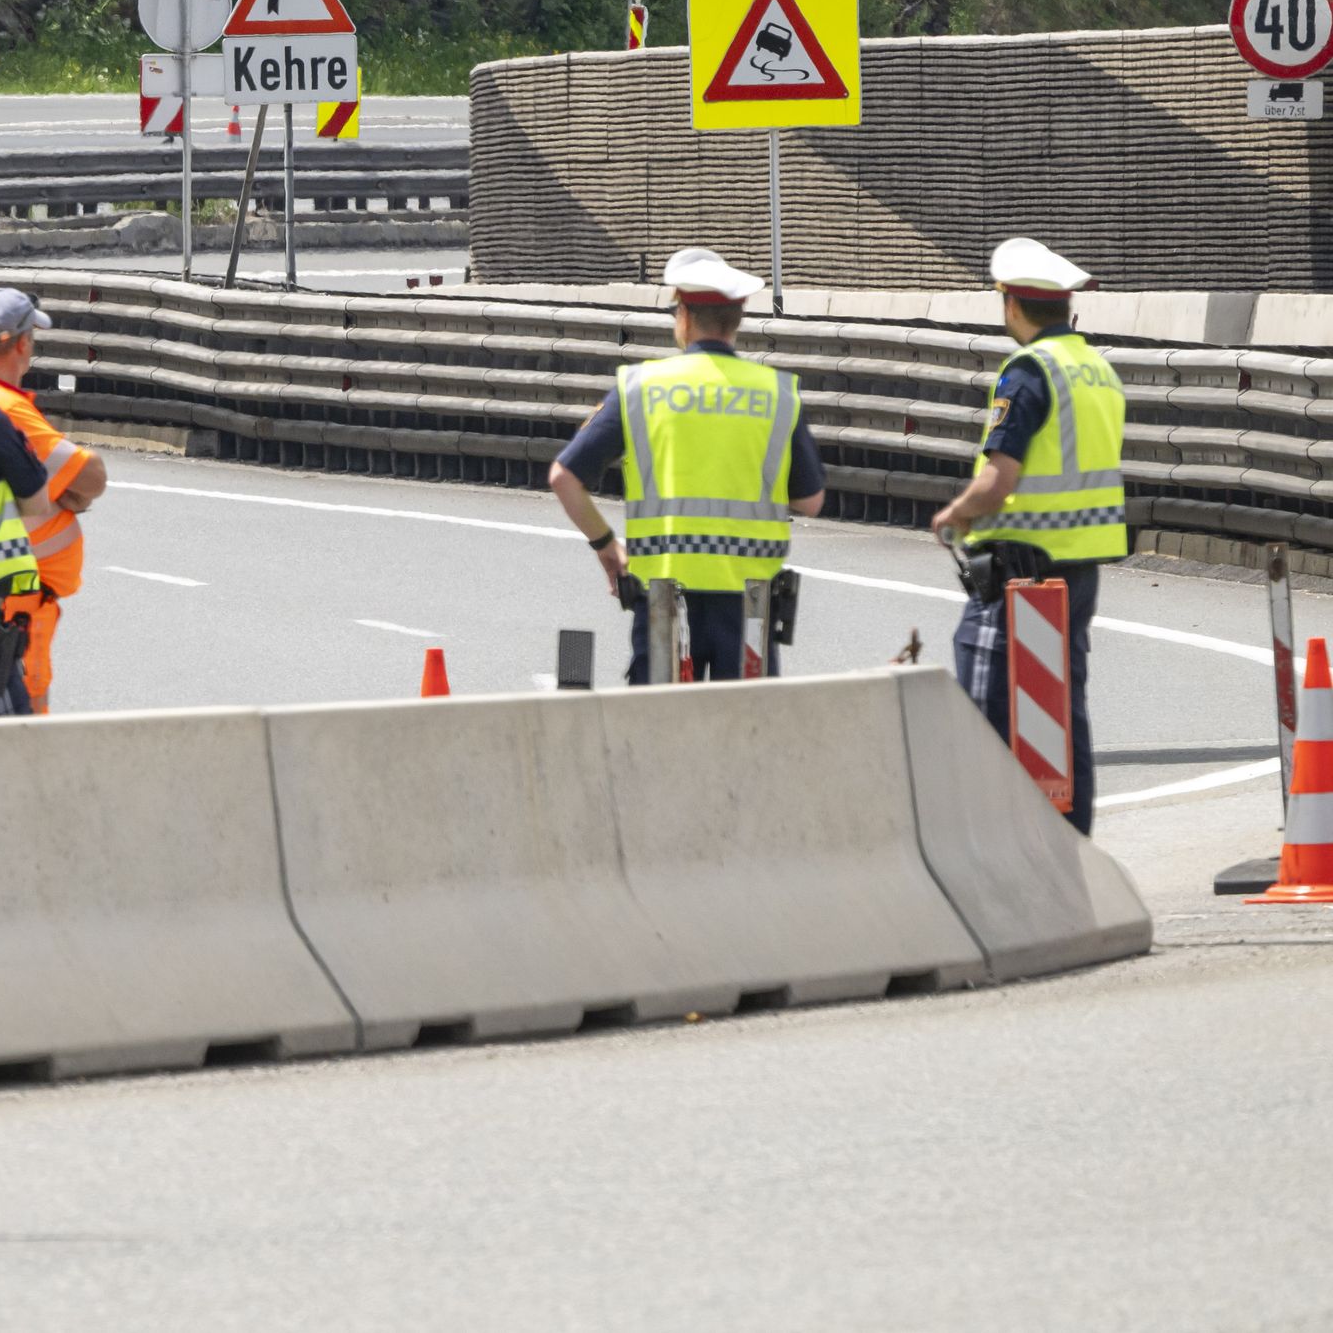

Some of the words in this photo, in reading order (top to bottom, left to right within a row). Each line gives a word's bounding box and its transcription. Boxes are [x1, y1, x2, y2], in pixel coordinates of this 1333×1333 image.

[234, 46, 348, 92] Kehre
[1264, 104, 1286, 116] über
[648, 384, 773, 419] POLIZEI
